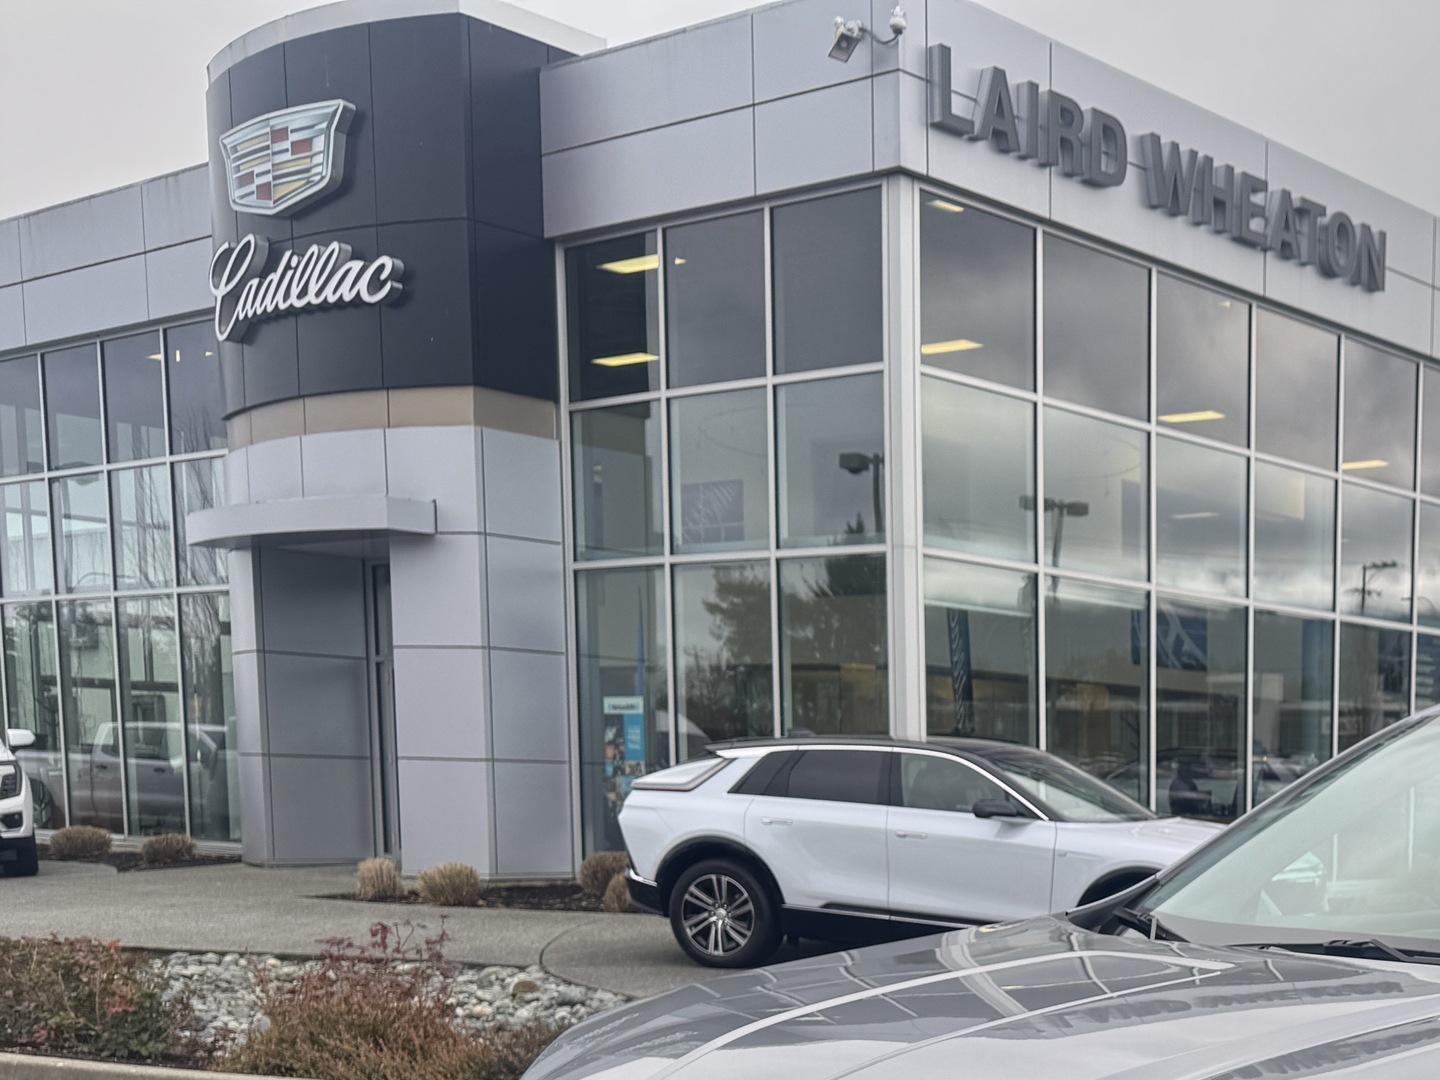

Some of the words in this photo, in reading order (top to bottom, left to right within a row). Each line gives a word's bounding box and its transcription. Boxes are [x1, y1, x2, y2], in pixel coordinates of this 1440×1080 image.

[928, 42, 1128, 188] LAIRD
[1140, 132, 1387, 292] WHEATON
[209, 233, 404, 342] Cadillac
